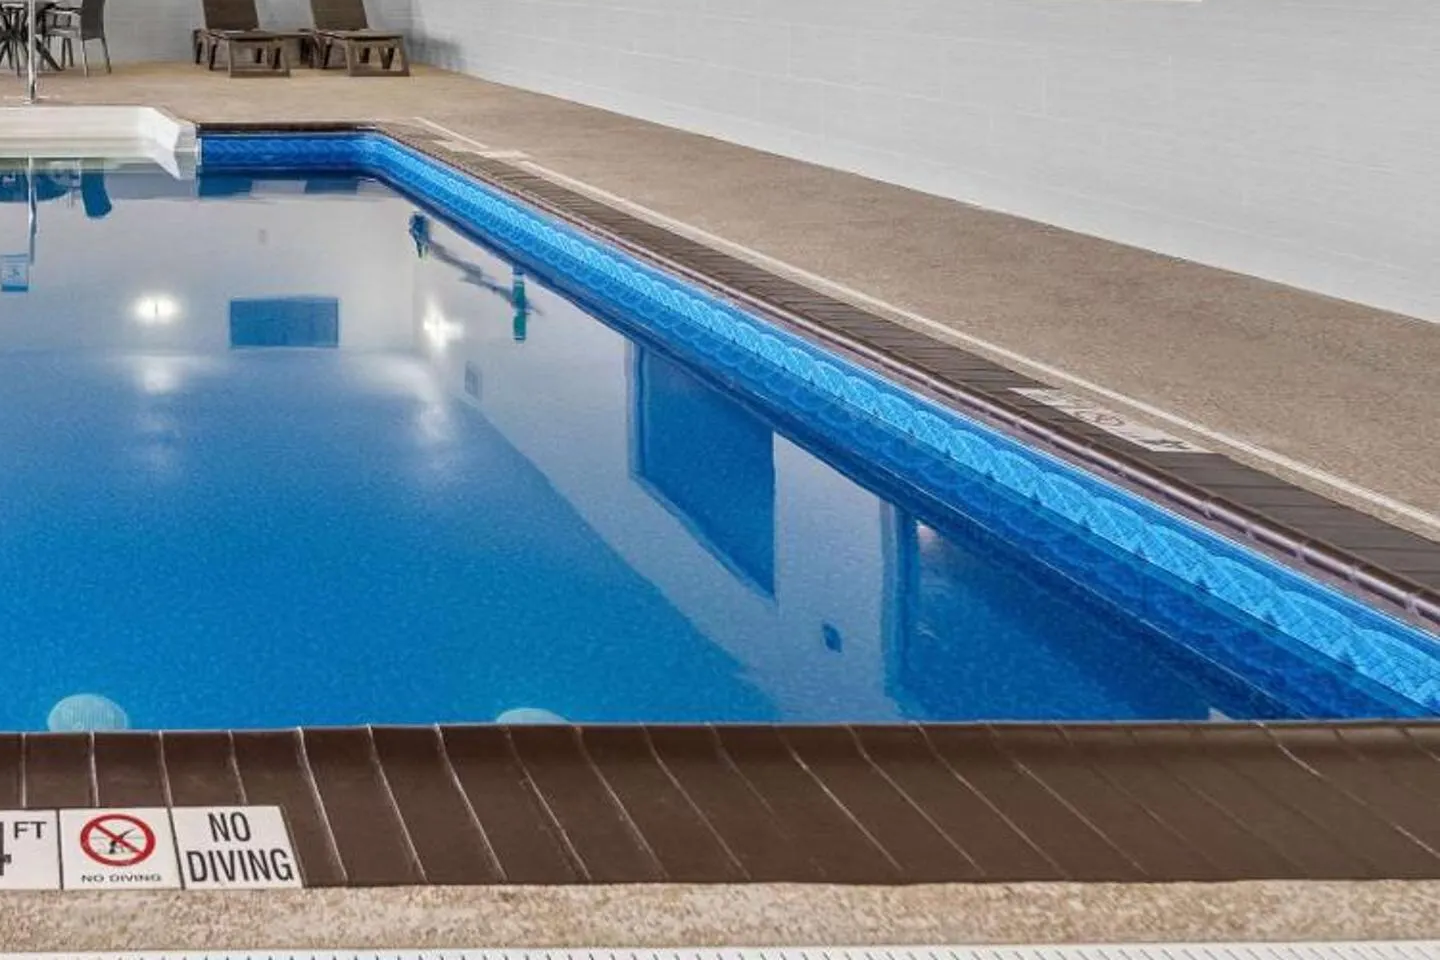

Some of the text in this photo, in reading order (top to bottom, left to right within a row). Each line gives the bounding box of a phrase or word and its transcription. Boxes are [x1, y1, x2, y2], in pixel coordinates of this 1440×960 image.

[14, 821, 47, 839] FT
[207, 812, 251, 843] NO
[186, 848, 294, 882] DIVING
[80, 873, 162, 883] NO DIVING
